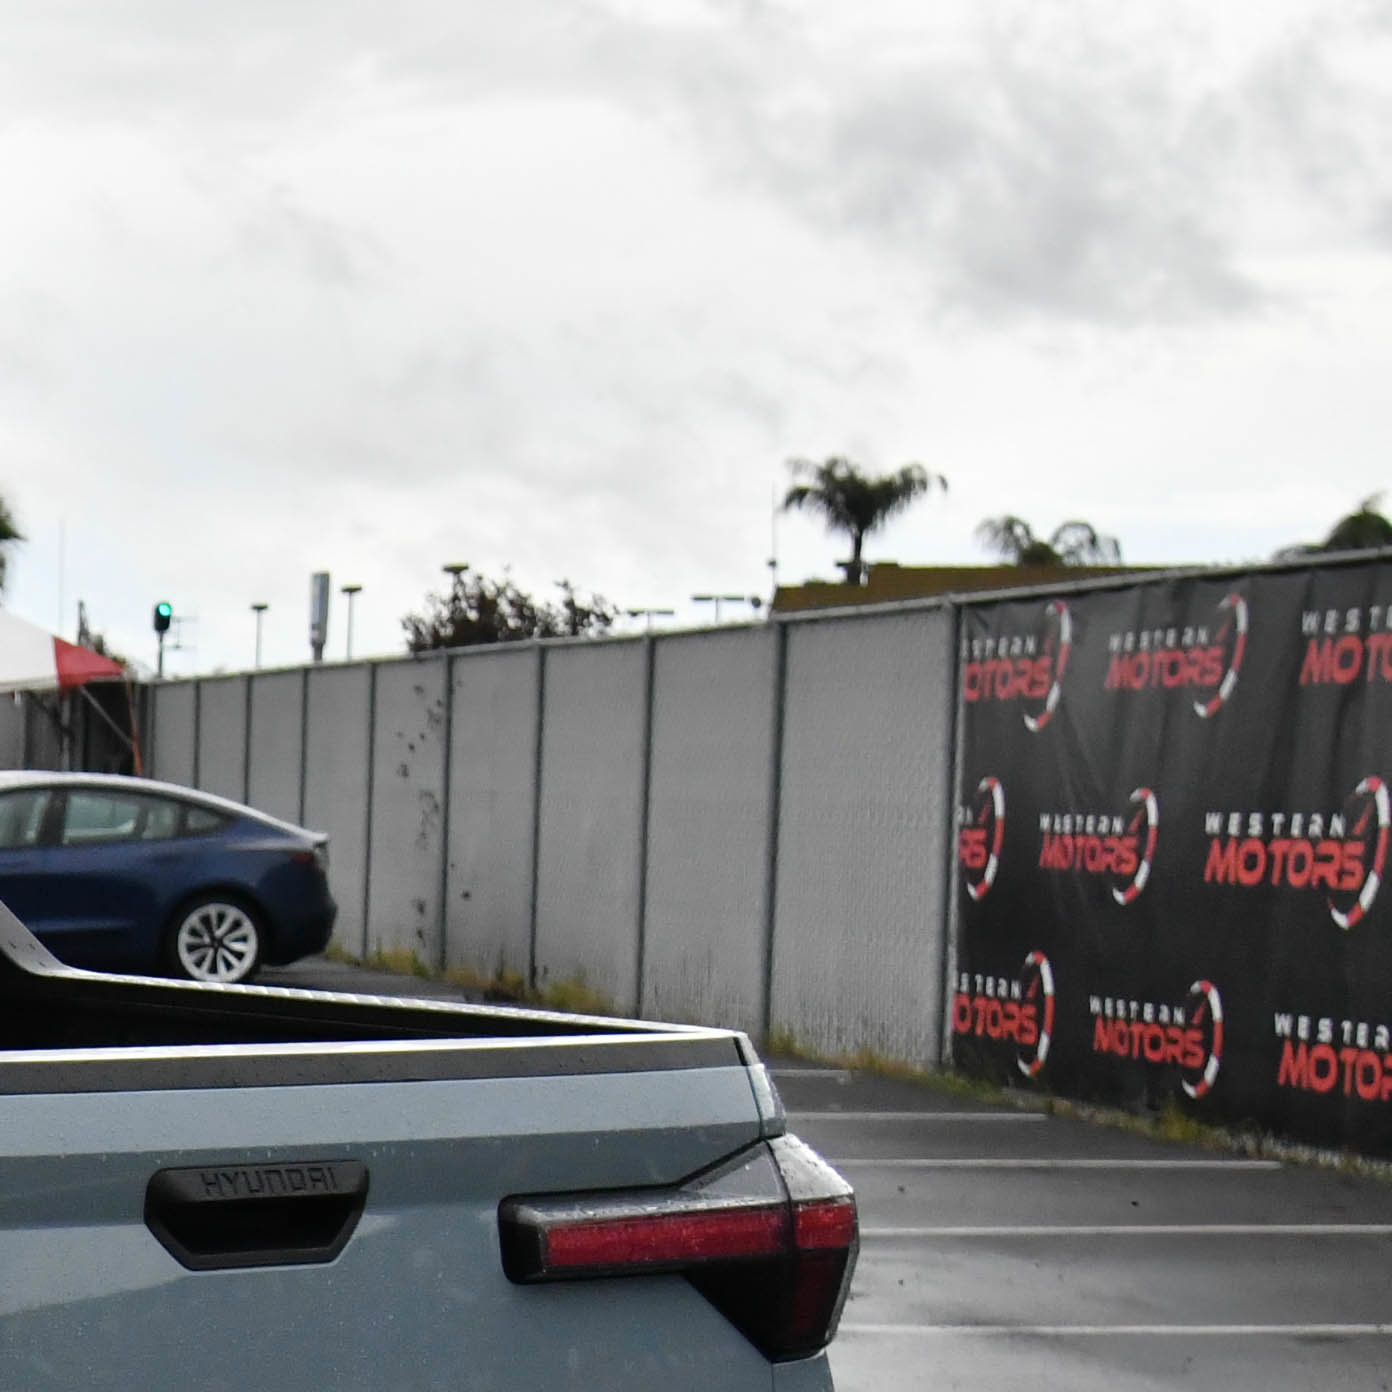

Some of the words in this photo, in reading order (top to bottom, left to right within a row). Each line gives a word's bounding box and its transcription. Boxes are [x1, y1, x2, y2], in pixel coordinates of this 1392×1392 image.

[964, 655, 1053, 701] OTORS
[1104, 645, 1225, 689] MOTORS
[1204, 812, 1347, 838] WESTERN
[1039, 832, 1139, 876] MOTORS
[1203, 836, 1365, 891] MOTORS
[952, 991, 1038, 1045] OTORS
[1274, 1012, 1391, 1050] WESTER
[1092, 1015, 1205, 1068] MOTORS
[200, 1166, 338, 1198] HYUNDAI
